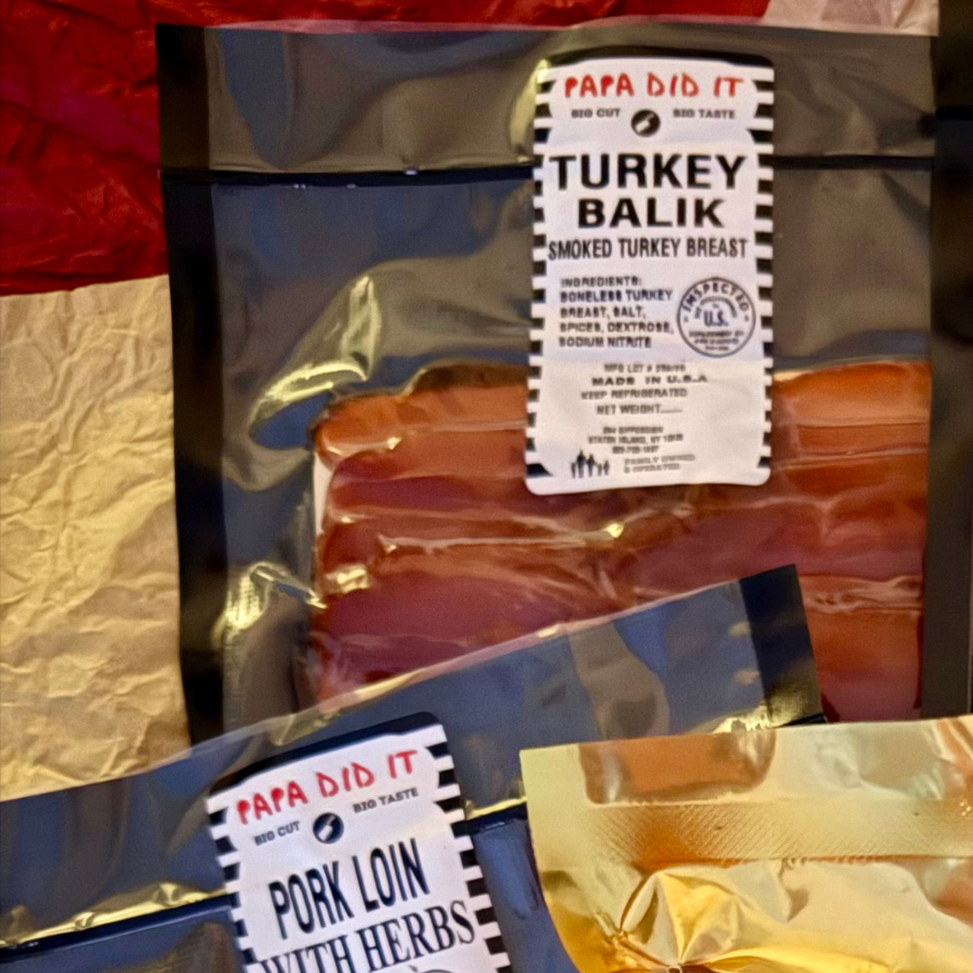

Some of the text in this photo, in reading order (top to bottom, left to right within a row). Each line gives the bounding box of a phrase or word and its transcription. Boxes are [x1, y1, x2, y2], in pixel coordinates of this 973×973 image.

[565, 72, 744, 97] PAPA DID IT
[572, 108, 620, 118] BIG CUT
[674, 109, 735, 119] BIG TASTE
[549, 153, 747, 190] TURKEY
[578, 198, 724, 228] BALIK
[548, 238, 747, 260] SMOKED TURKEY BREAST
[561, 276, 642, 287] INGREDIENTS:
[560, 290, 673, 302] BONELESS TURKEY
[682, 282, 749, 312] INSPECTED
[560, 306, 646, 319] BREAST, SALT,
[559, 322, 674, 334] SPICES, DEXTROSE,
[559, 337, 651, 348] SODIUM NITRITE
[592, 374, 707, 386] MADE IN U.S.A
[581, 388, 687, 400] KEEP REFRIGERATED
[597, 405, 615, 415] NET
[236, 750, 417, 824] PAPA DID IT
[353, 787, 418, 814] BIG TASTE
[255, 821, 299, 845] BIG CUT
[268, 838, 430, 940] PORK LOIN
[356, 900, 475, 972] HERBS
